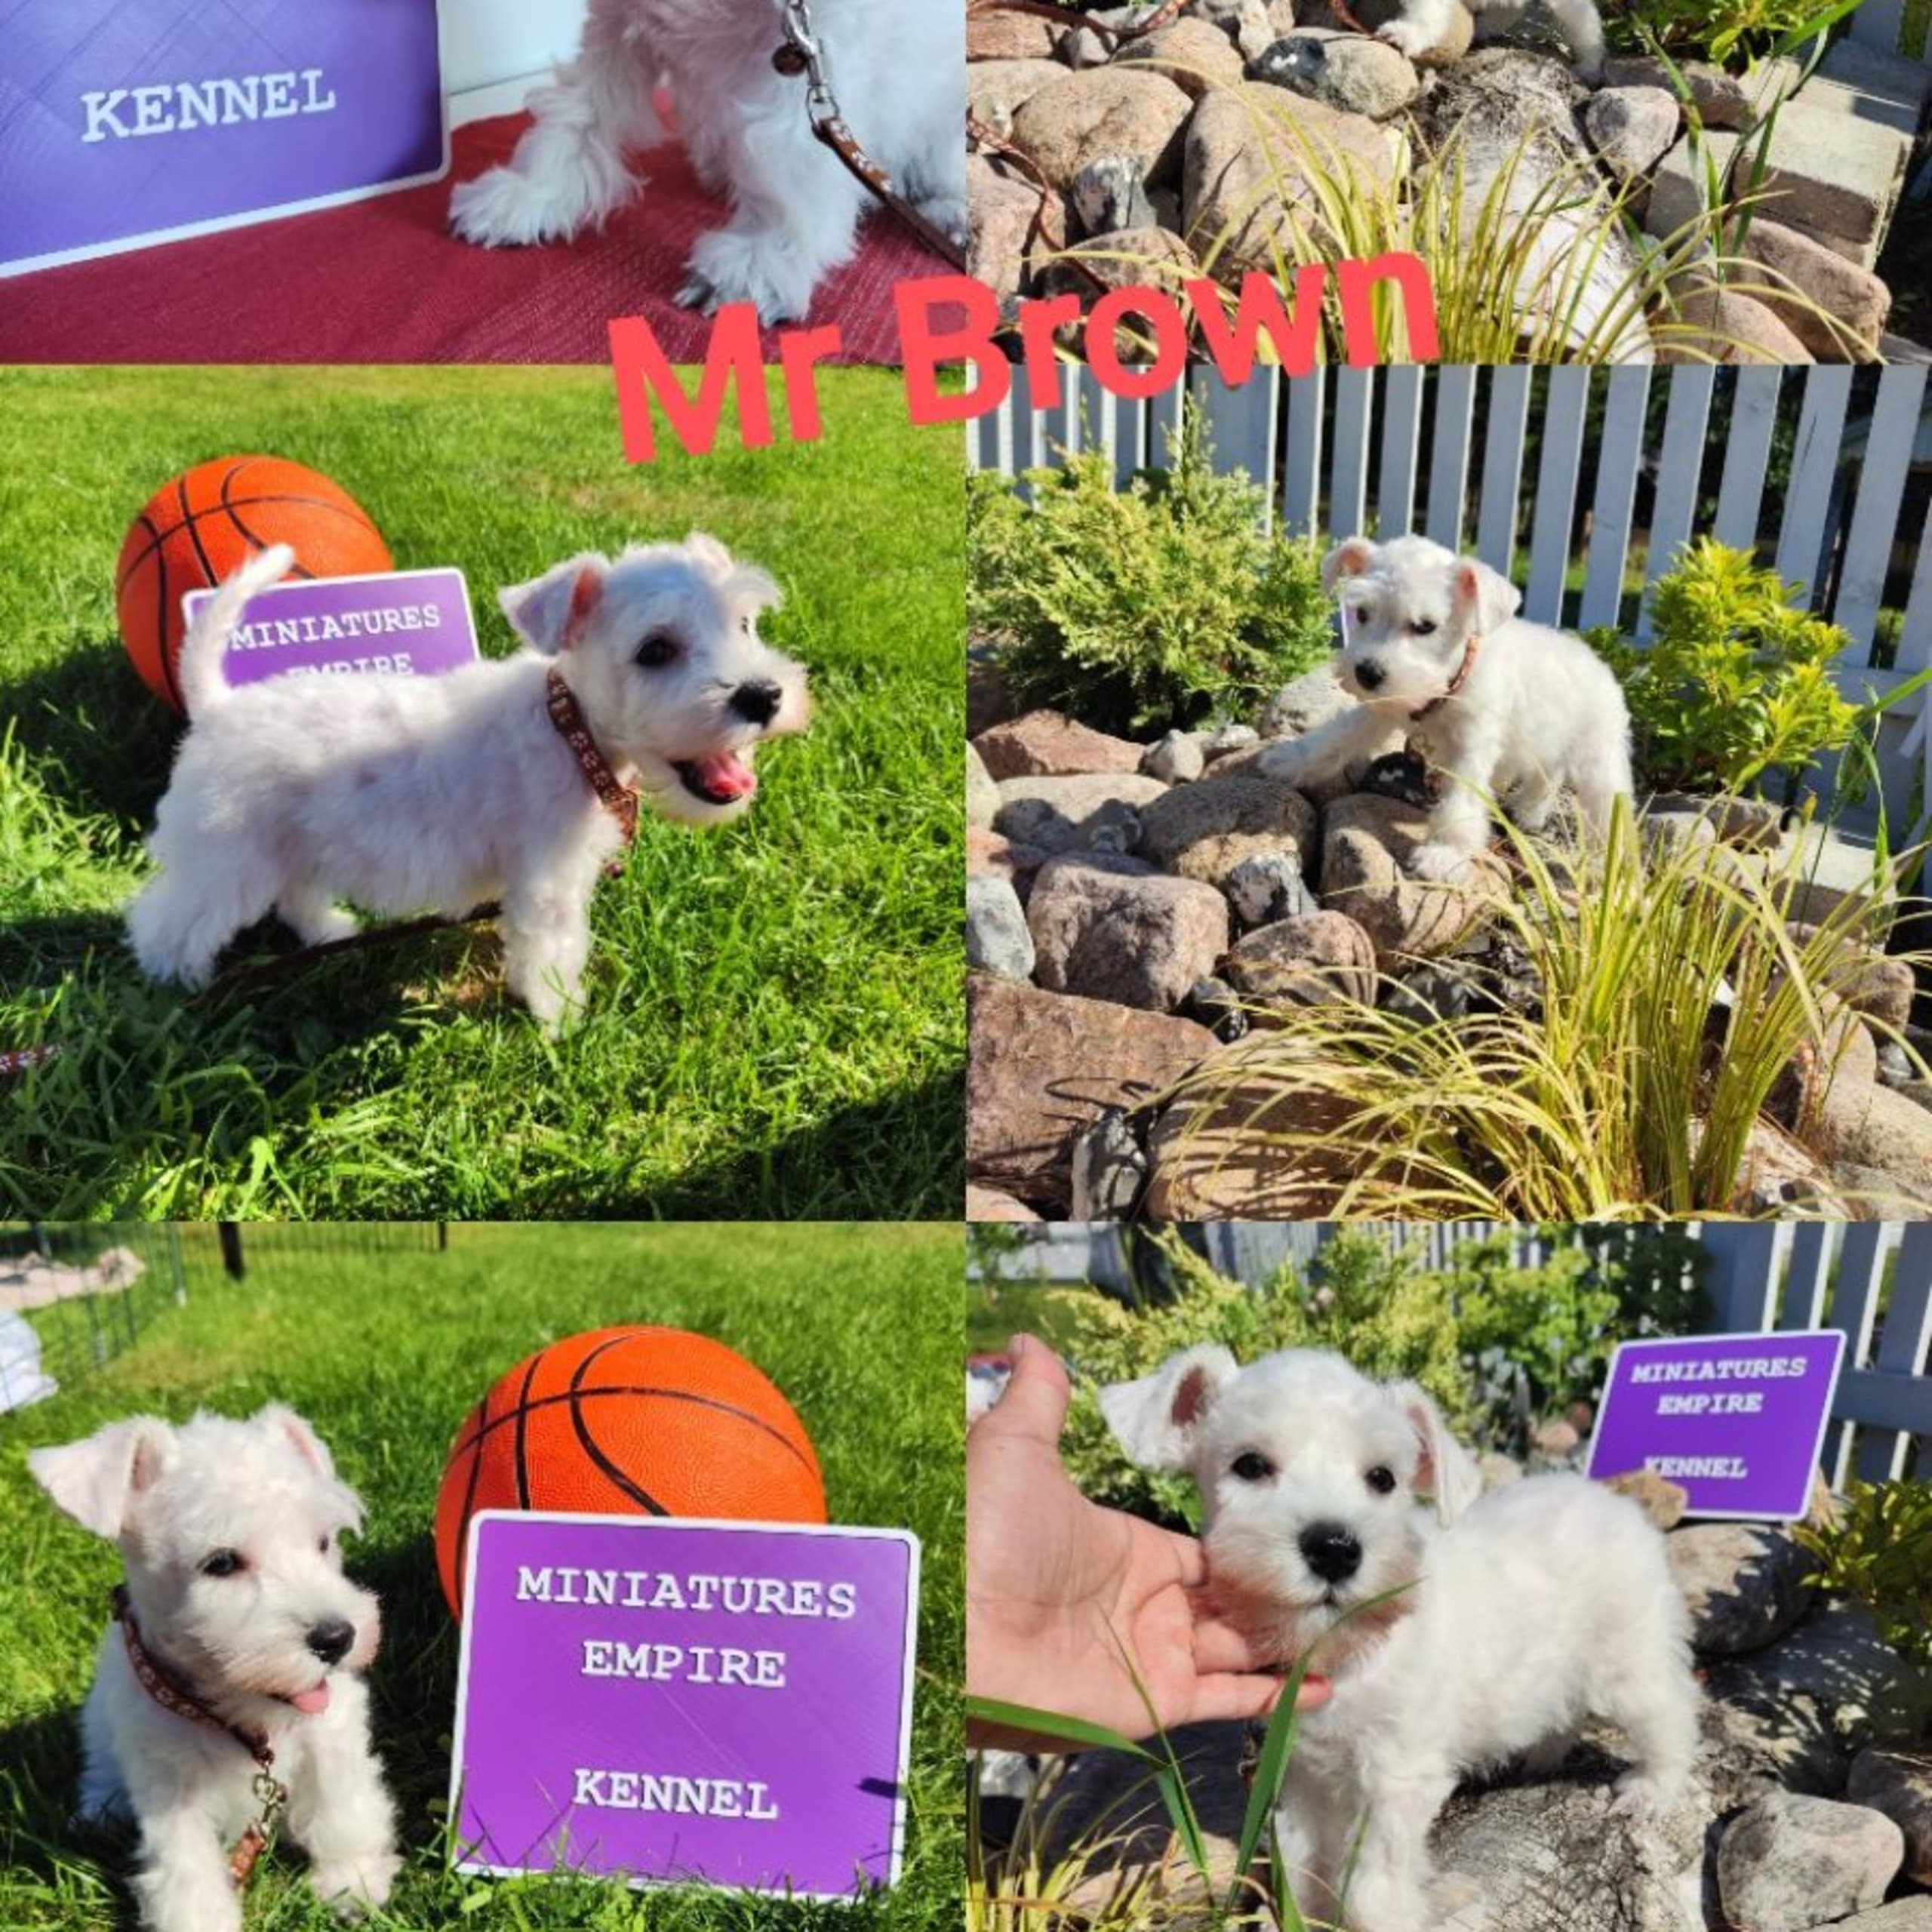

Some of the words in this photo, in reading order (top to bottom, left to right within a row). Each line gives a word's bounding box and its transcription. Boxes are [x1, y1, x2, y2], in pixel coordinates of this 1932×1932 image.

[80, 69, 337, 143] KENNEL
[228, 604, 441, 651] MINIATURES
[1630, 1358, 1807, 1383] MINIATURES
[1657, 1393, 1764, 1414] EMPIRE
[516, 1566, 857, 1619] MINIATURES
[581, 1640, 787, 1687] EMPIRE
[573, 1768, 780, 1820] KENNEL
